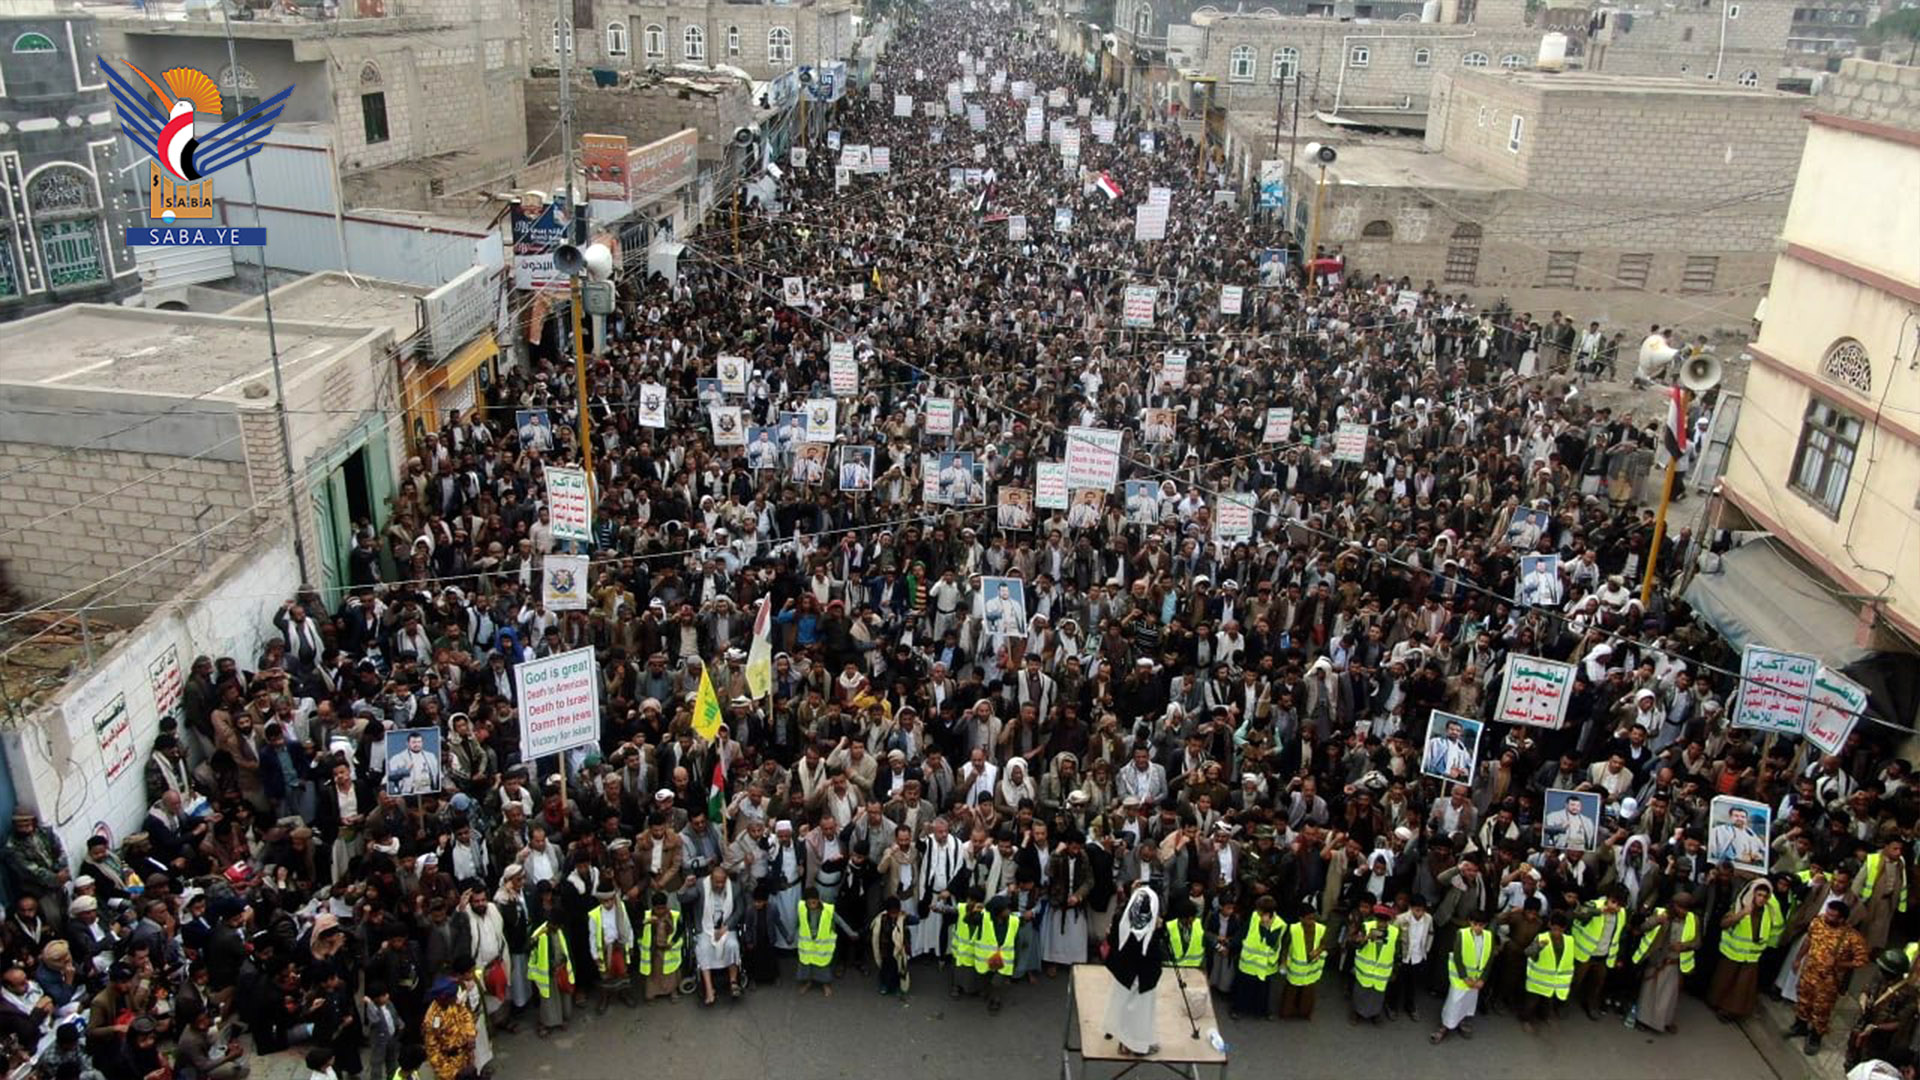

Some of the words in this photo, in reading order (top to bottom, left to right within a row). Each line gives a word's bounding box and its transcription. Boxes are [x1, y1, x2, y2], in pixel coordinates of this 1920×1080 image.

[525, 668, 548, 685] God
[549, 666, 560, 679] is
[561, 660, 588, 680] great
[1788, 664, 1812, 675] الله
[528, 700, 555, 717] Death
[555, 699, 565, 710] to
[566, 694, 590, 707] Israel
[530, 718, 556, 733] Damn
[557, 714, 571, 726] the
